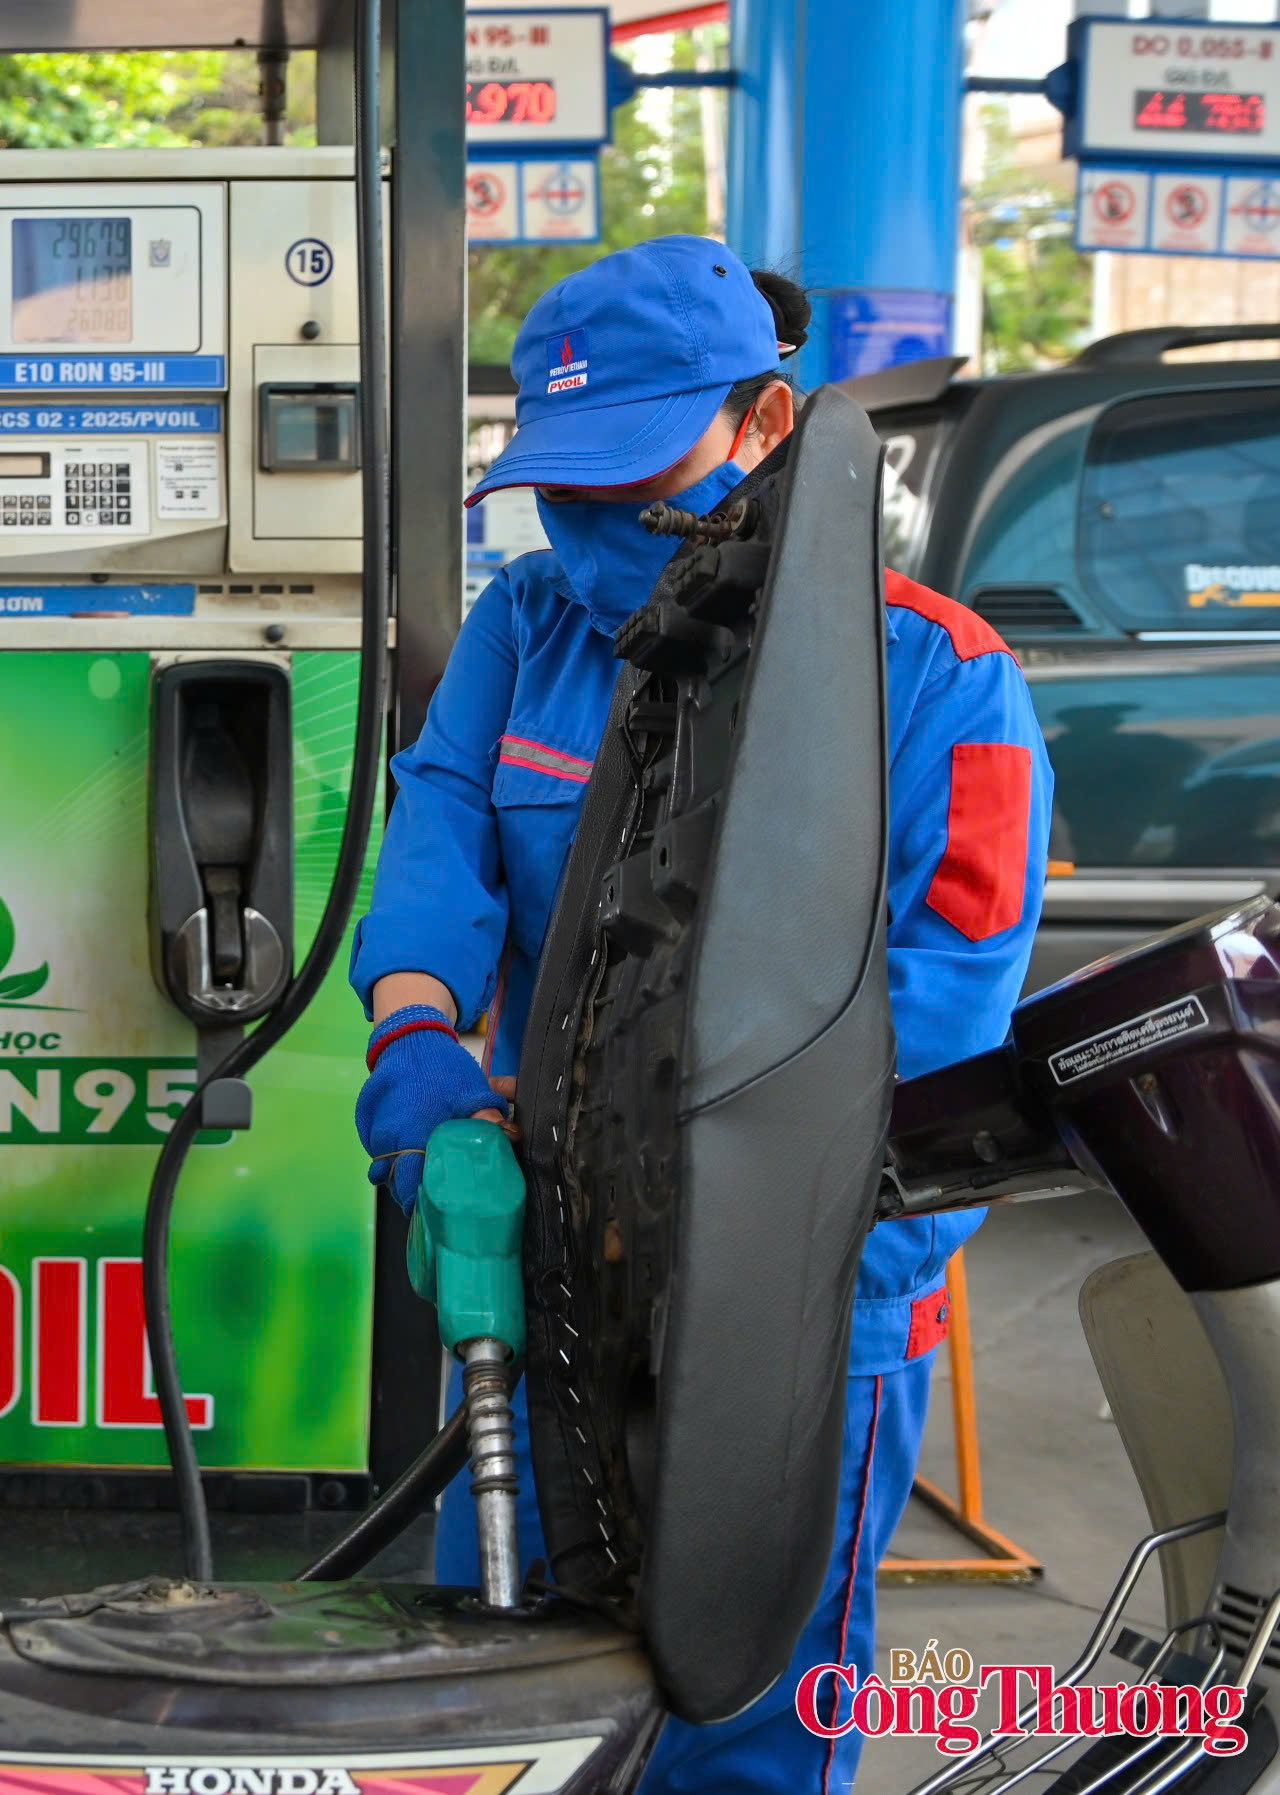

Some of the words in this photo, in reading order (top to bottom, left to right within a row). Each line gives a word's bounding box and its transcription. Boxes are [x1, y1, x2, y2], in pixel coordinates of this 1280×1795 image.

[296, 248, 325, 275] 15
[15, 362, 54, 382] E10
[60, 362, 104, 382] RON
[110, 361, 166, 382] 95-III
[549, 376, 584, 393] PVOIL
[36, 412, 62, 428] 02
[81, 411, 200, 428] 2025/PVOIL
[144, 1767, 362, 1795] HONDA
